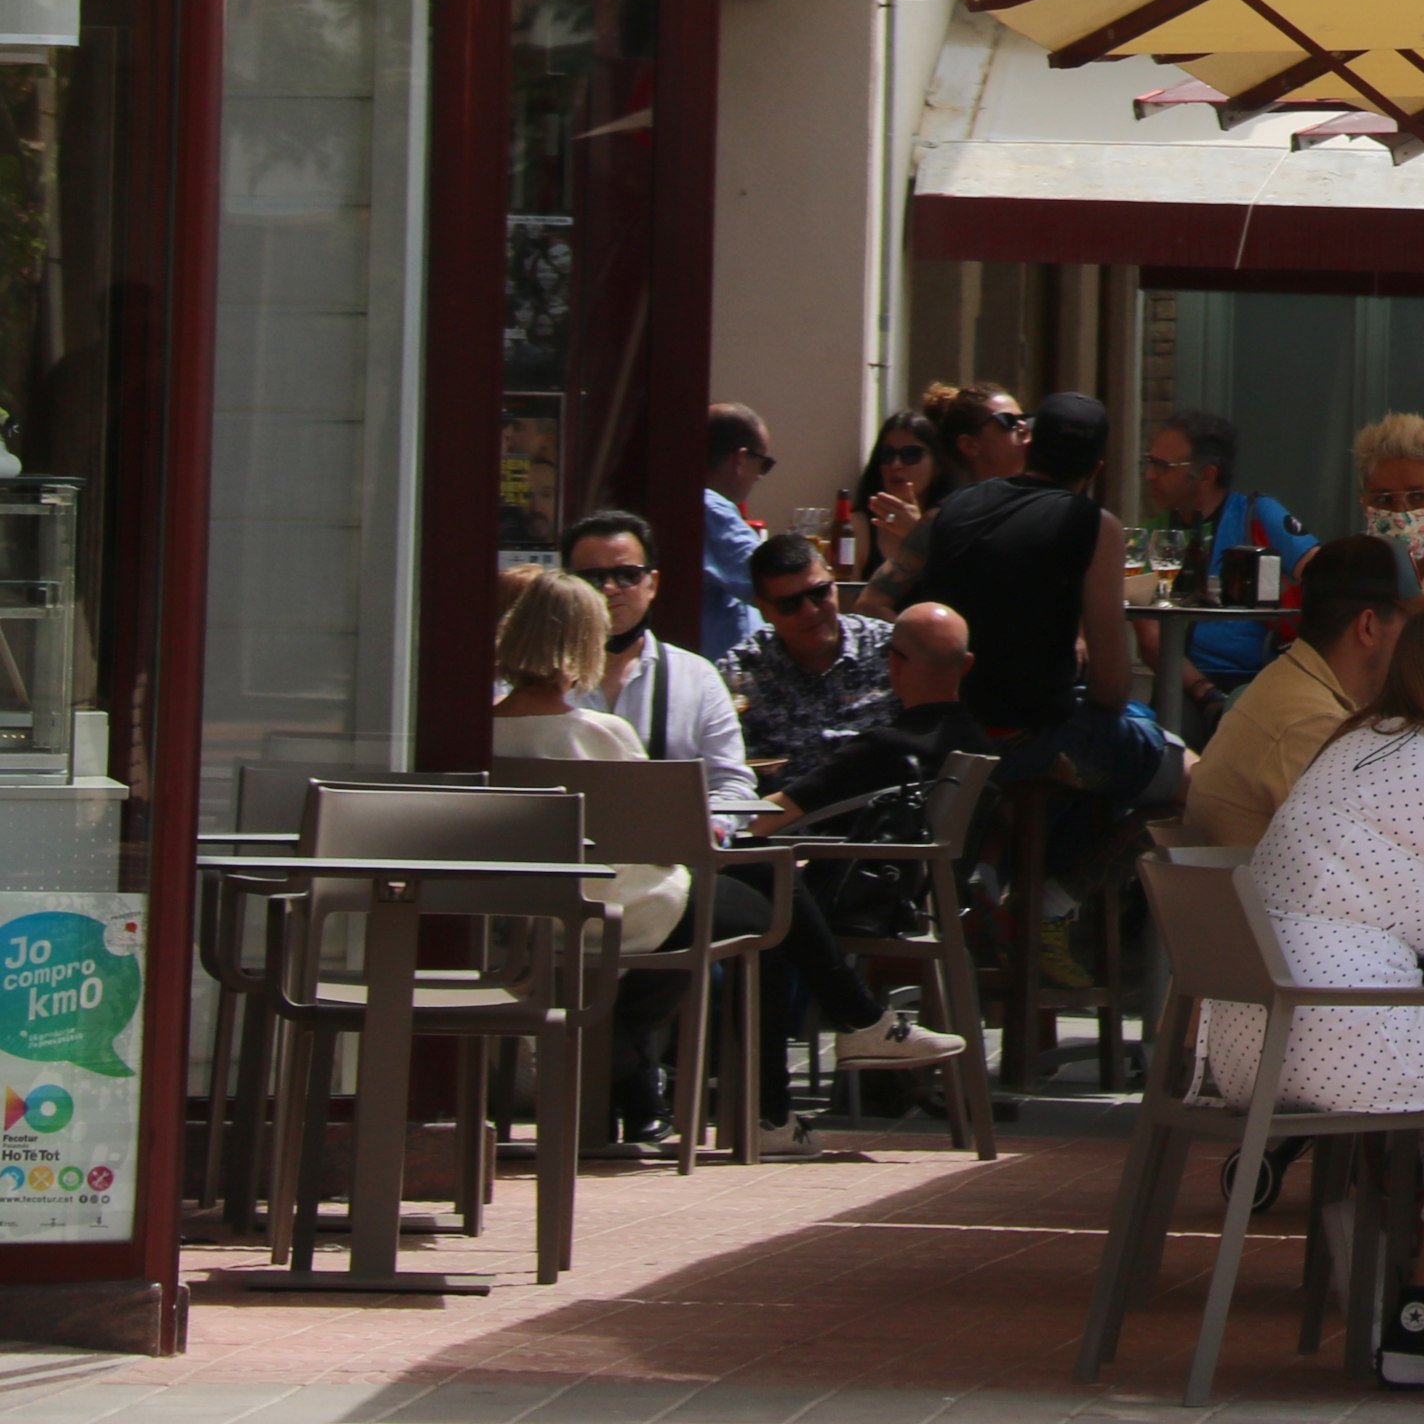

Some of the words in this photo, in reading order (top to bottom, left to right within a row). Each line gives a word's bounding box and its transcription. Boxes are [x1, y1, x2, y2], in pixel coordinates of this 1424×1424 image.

[5, 936, 52, 969] Jo
[3, 959, 96, 991] compro
[28, 977, 104, 1021] km0
[2, 1134, 39, 1143] Fecotur
